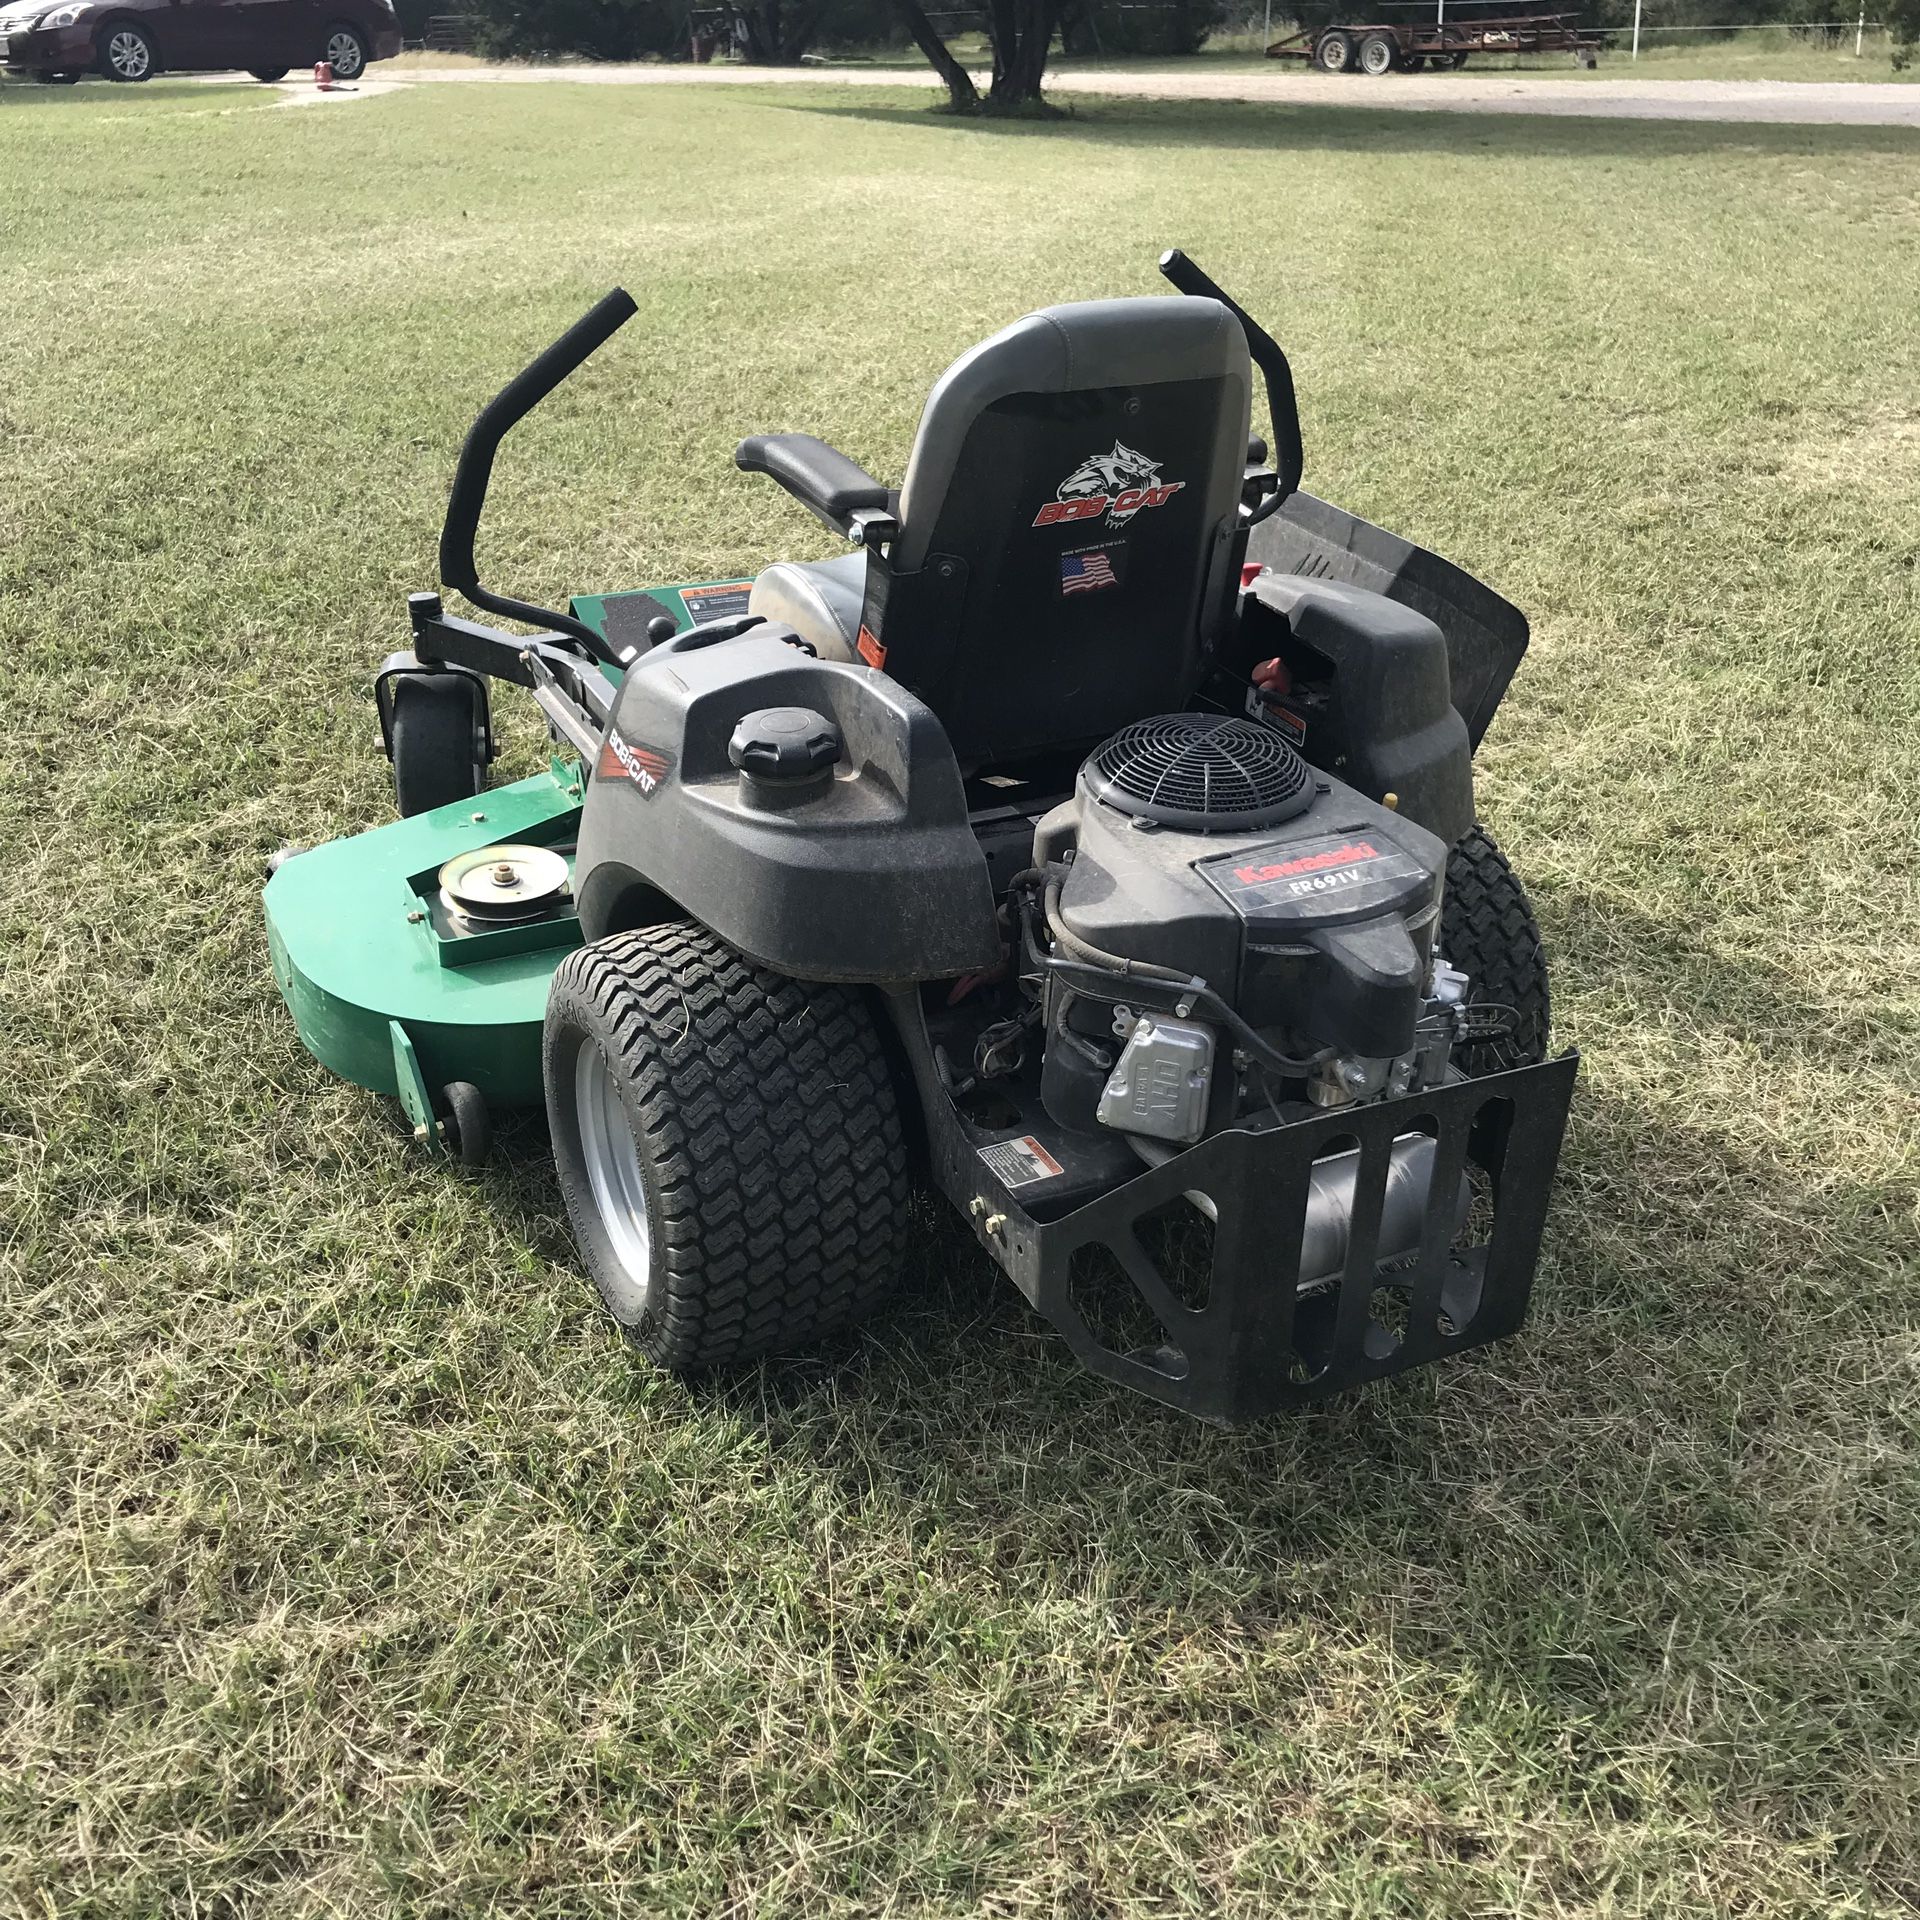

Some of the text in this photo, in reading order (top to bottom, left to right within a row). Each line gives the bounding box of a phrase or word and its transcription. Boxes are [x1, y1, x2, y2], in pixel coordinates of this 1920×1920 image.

[1233, 840, 1378, 885] Kawasaki
[1289, 869, 1360, 896] FR691V
[1151, 1059, 1180, 1121] OHV
